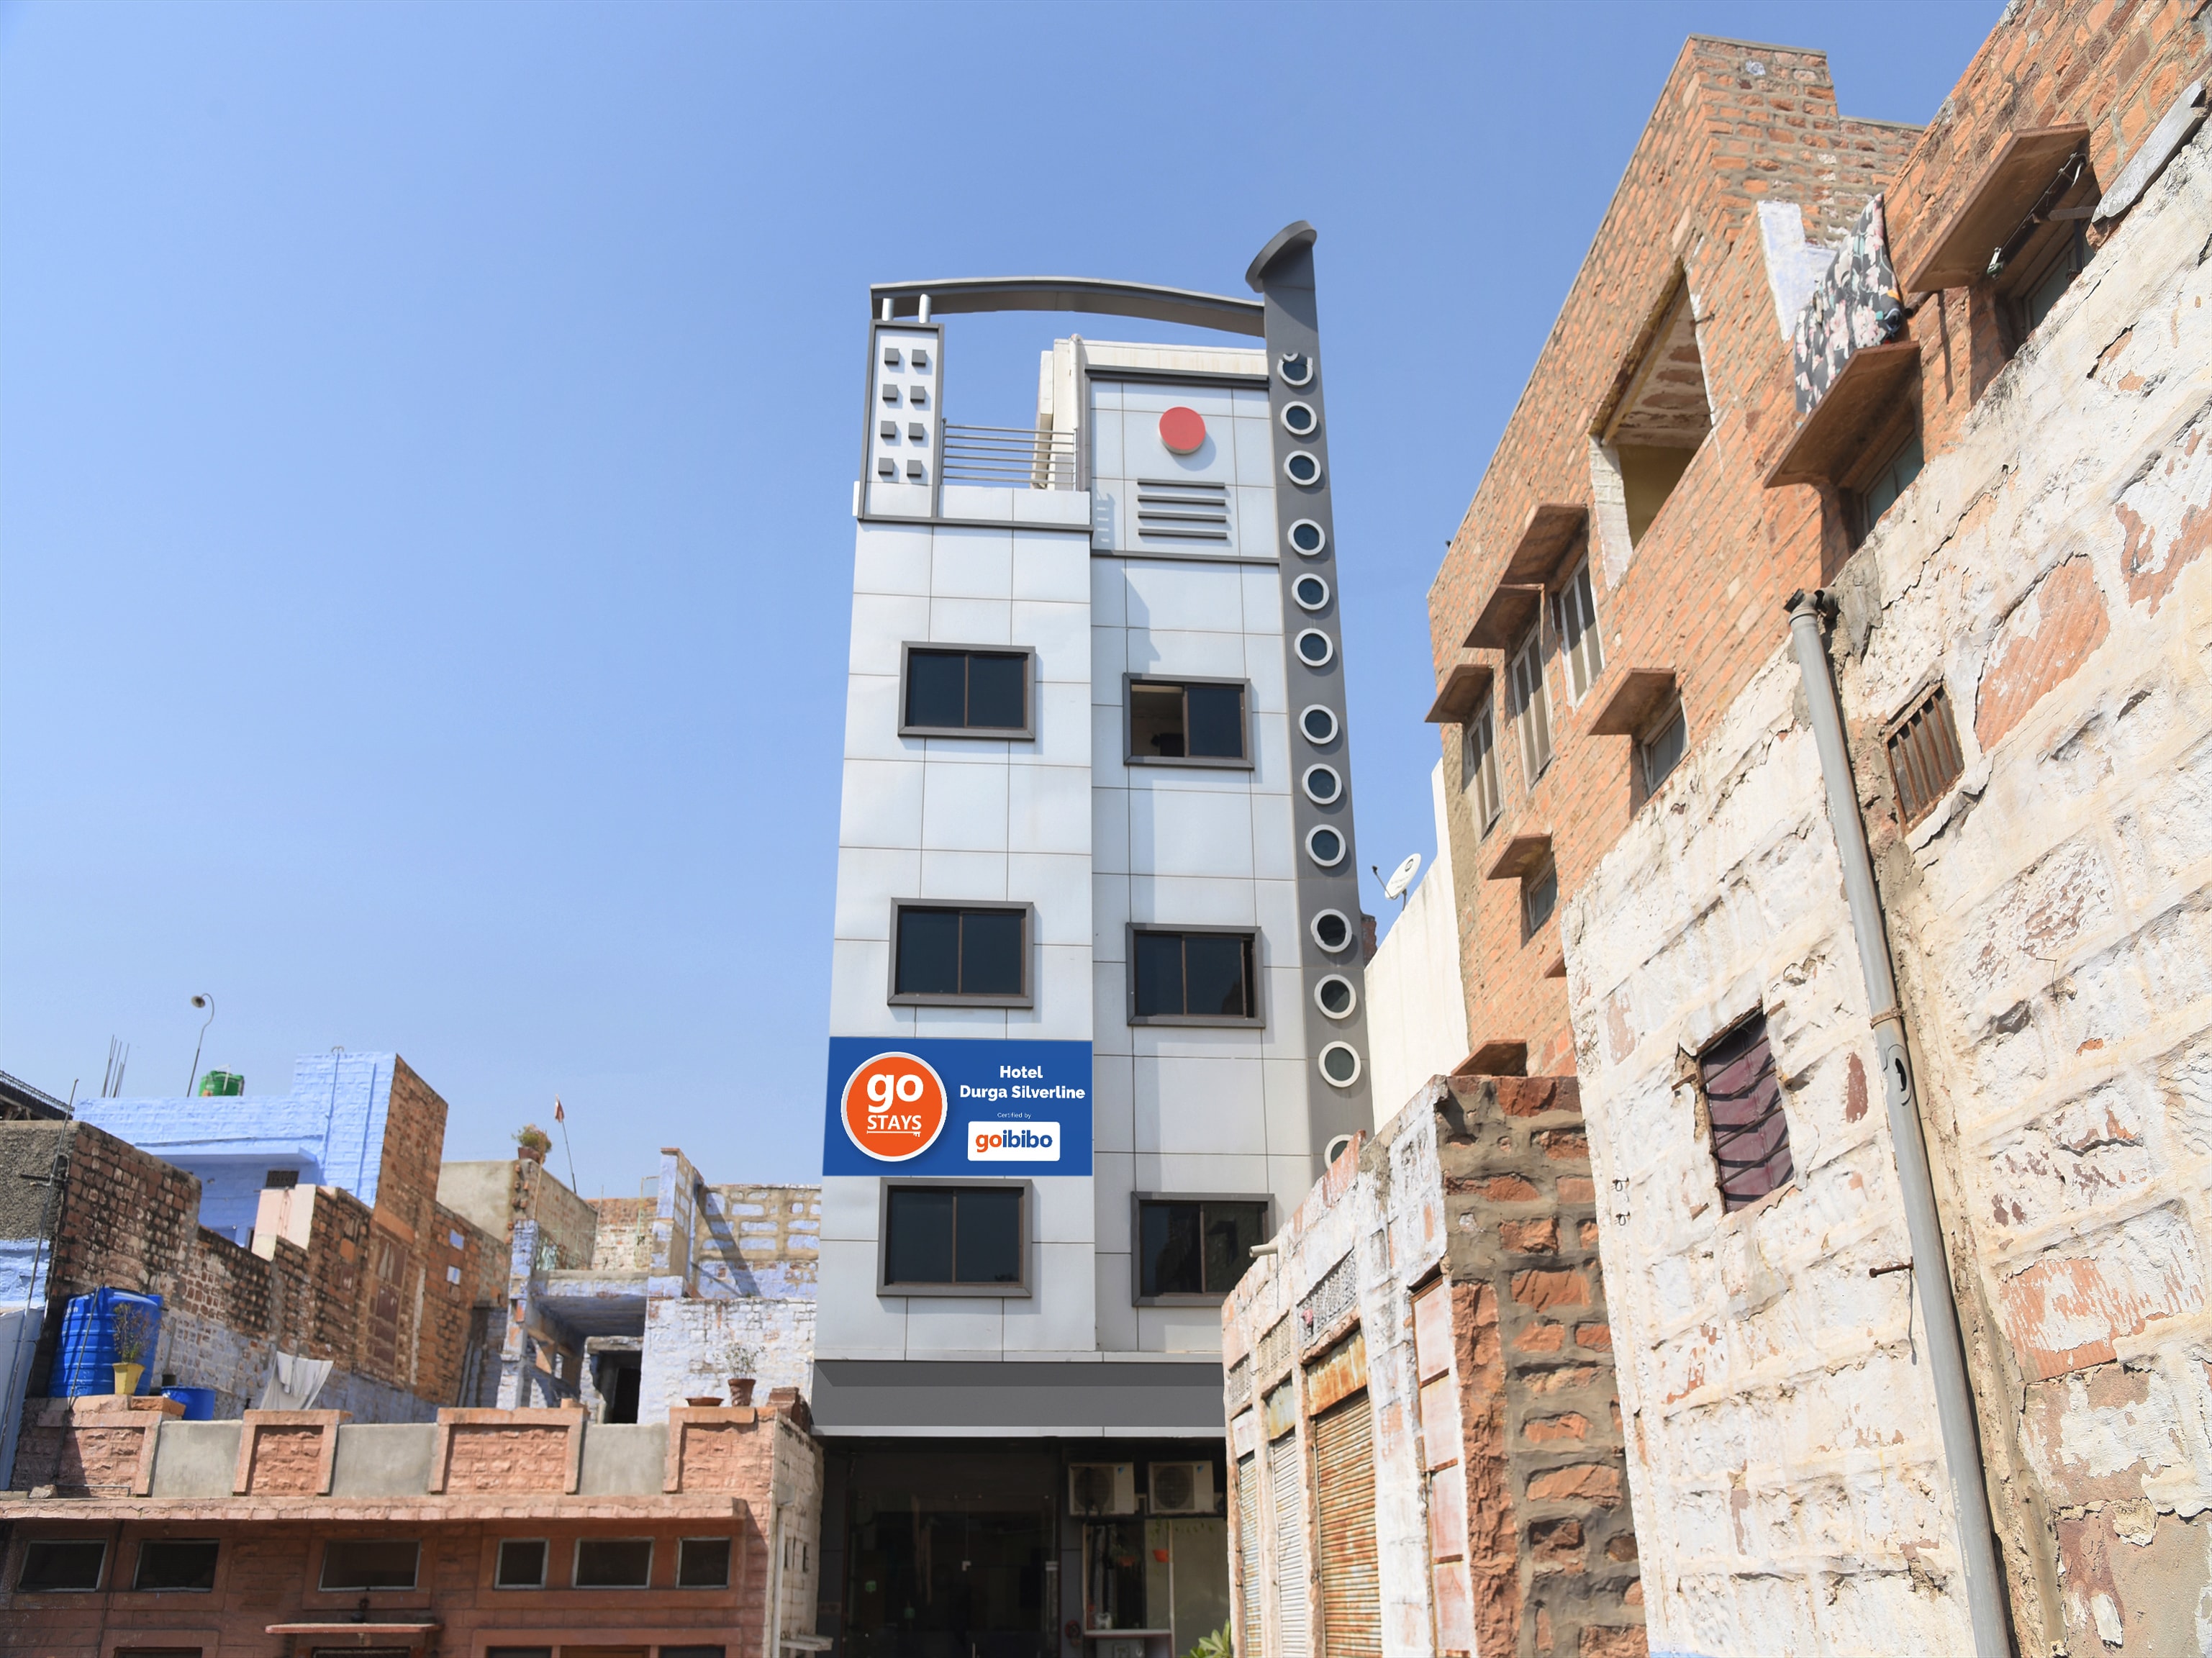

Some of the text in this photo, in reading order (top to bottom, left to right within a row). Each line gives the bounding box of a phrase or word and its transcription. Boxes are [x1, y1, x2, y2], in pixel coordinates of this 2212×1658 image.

[1000, 1065, 1043, 1079] Hotel
[866, 1074, 924, 1113] go
[960, 1084, 1085, 1102] Durga Silverline
[867, 1115, 922, 1131] STAYS
[975, 1129, 1053, 1153] goibibo
